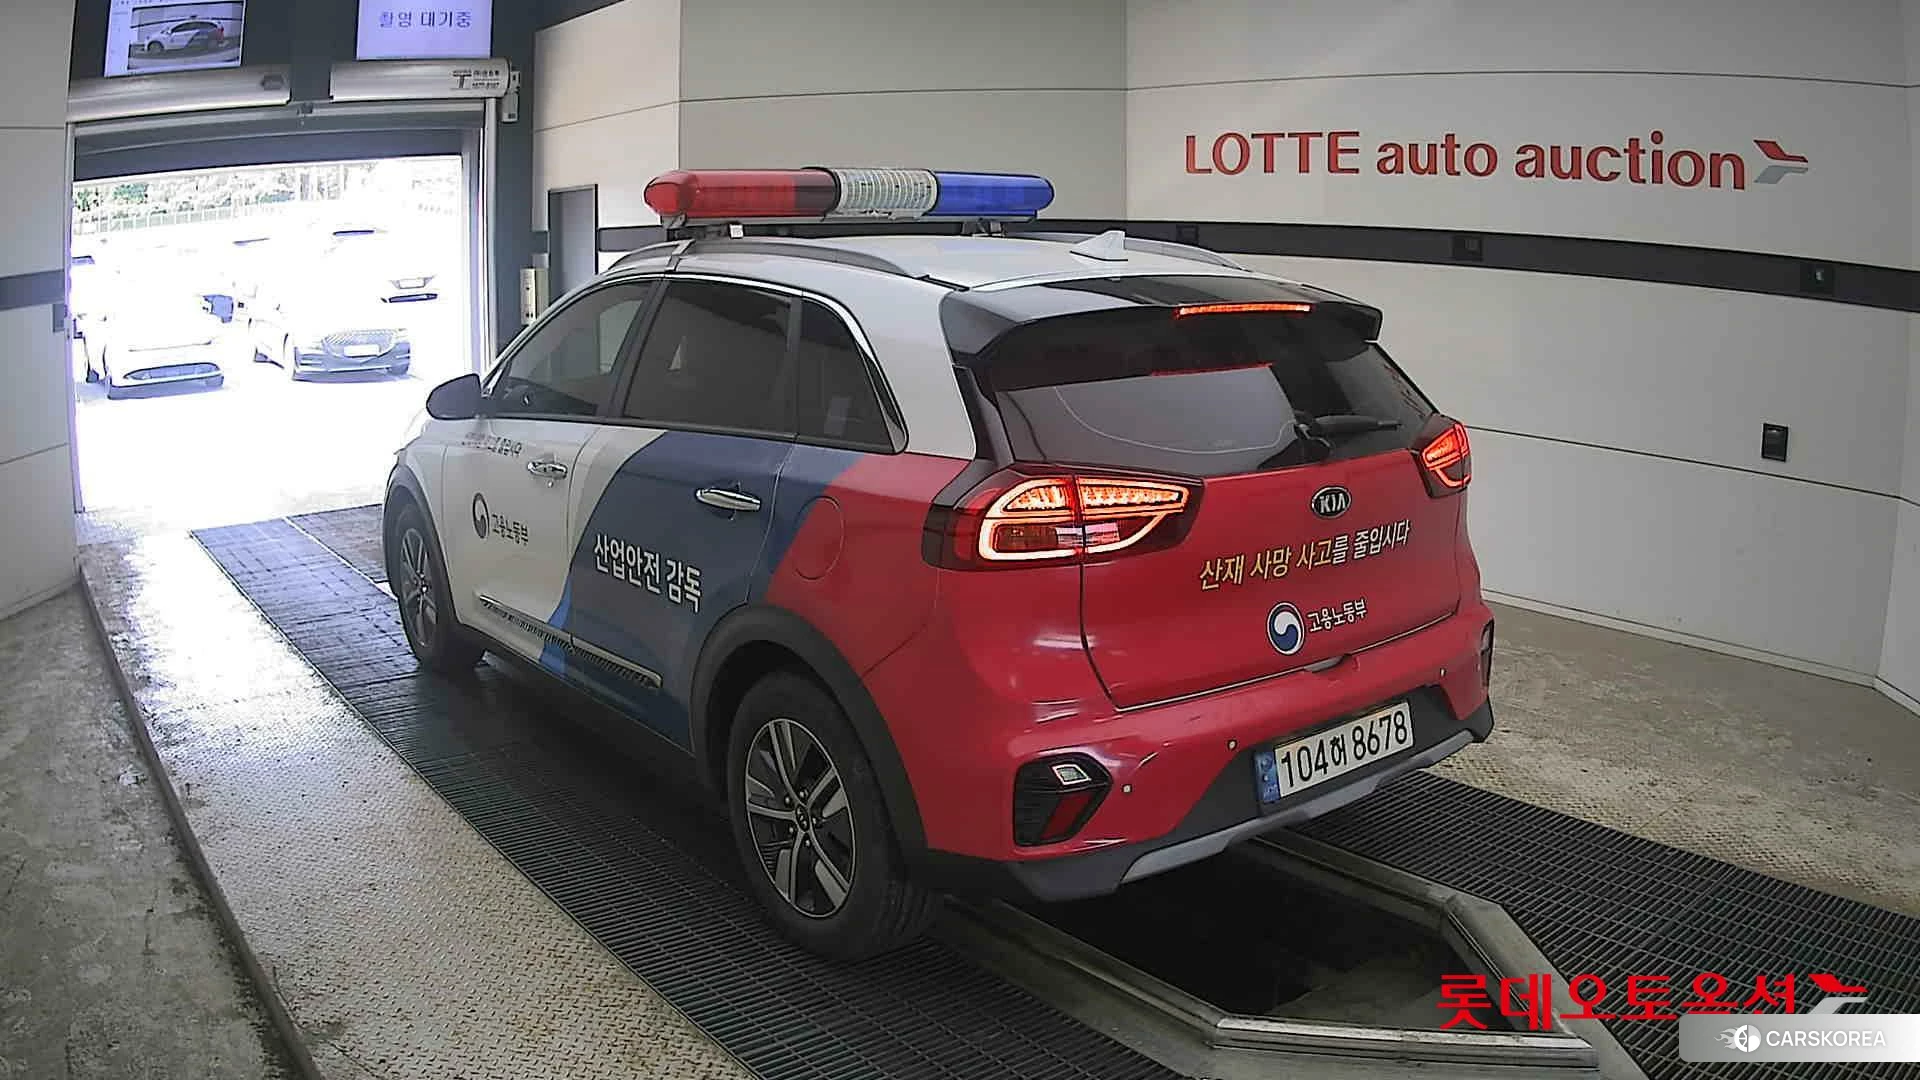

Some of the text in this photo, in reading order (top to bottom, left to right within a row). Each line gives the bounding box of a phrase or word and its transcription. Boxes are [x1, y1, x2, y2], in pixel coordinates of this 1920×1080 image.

[420, 10, 472, 28] 대기중
[1185, 130, 1746, 190] LOTTE auto auction
[1319, 493, 1347, 514] KIA
[594, 533, 702, 614] 산업안전 감독
[1199, 519, 1411, 592] 산재 사망 사고를 줄입시다
[1307, 598, 1367, 633] 고용노동부
[1281, 710, 1408, 788] 104허 8678
